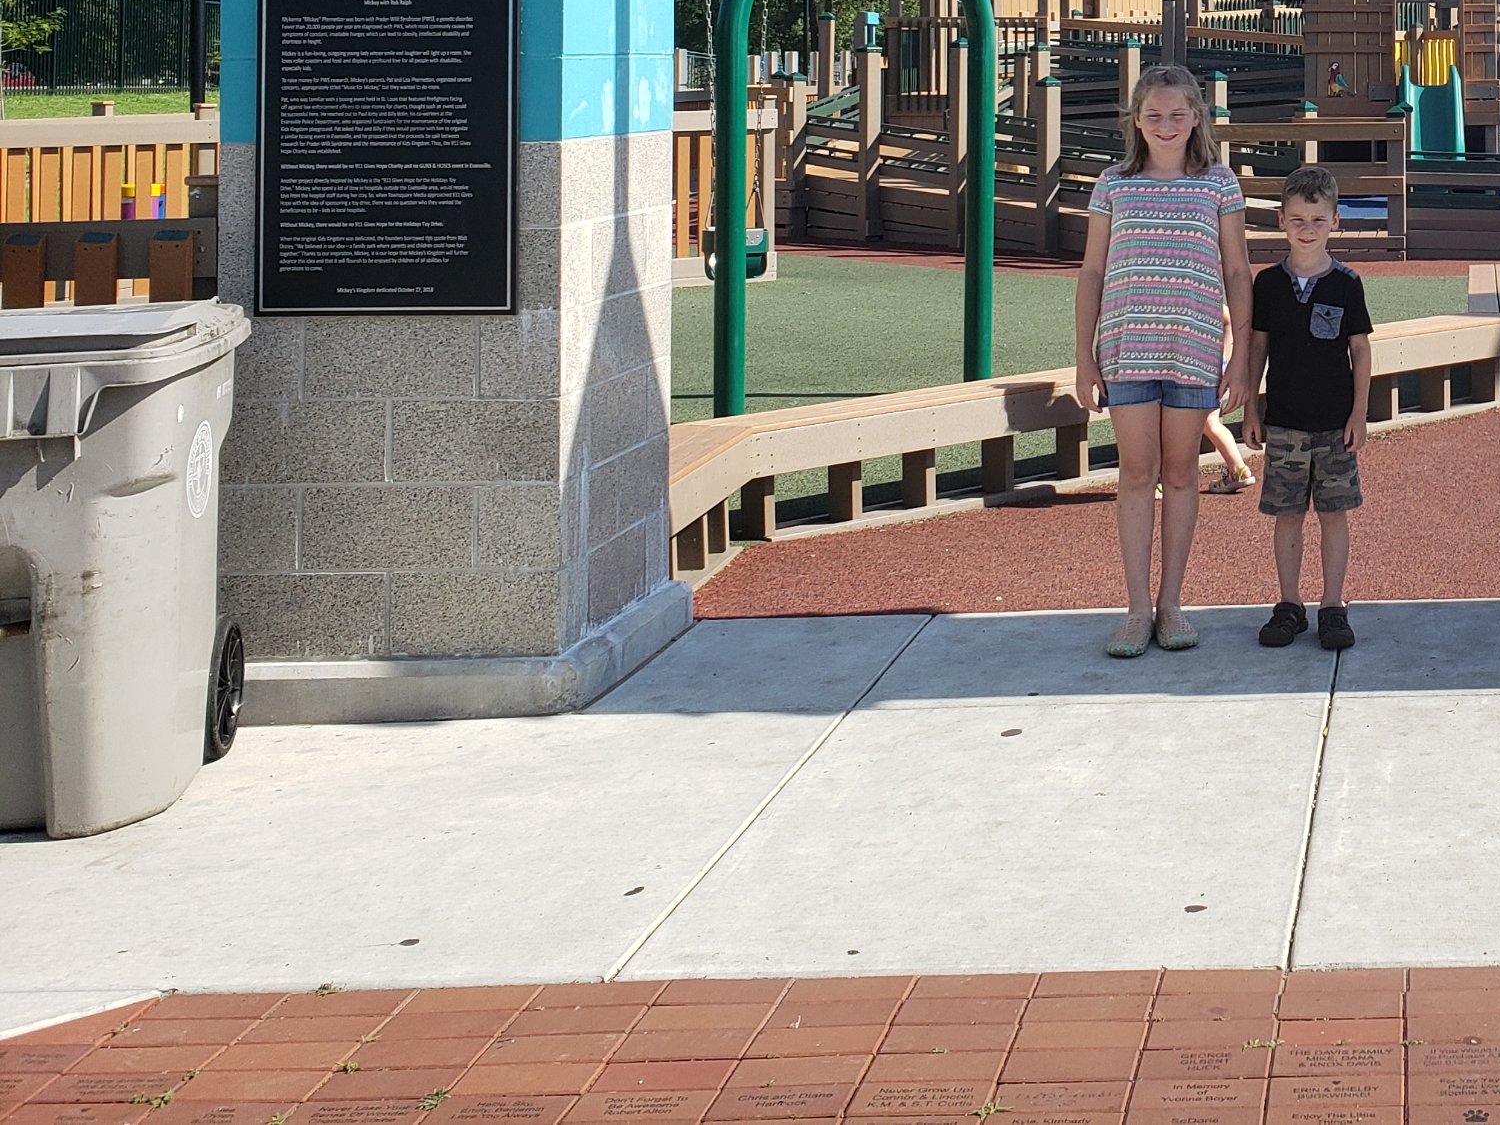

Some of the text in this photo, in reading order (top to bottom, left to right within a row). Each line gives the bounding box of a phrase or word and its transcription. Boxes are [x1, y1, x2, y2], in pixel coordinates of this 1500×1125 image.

[605, 1096, 632, 1105] Don't
[632, 1096, 672, 1105] Forget
[737, 1092, 833, 1102] Chris and Diane
[627, 1101, 680, 1109] Awesome
[603, 1108, 641, 1116] Robert
